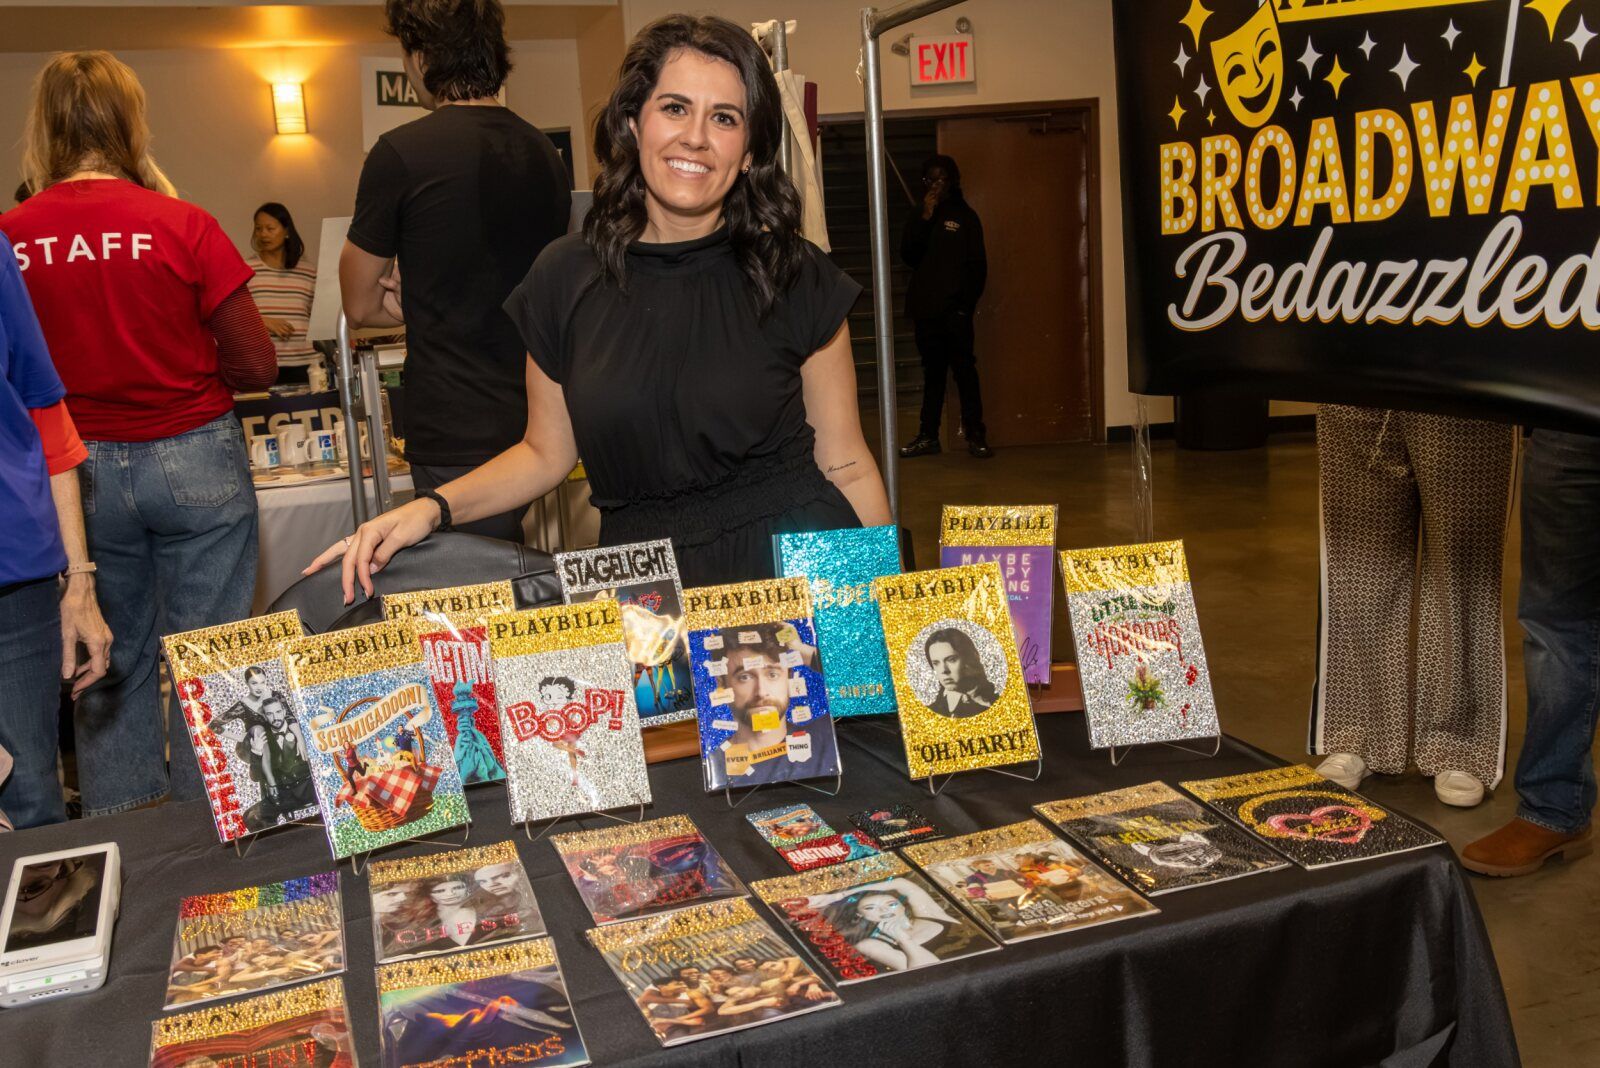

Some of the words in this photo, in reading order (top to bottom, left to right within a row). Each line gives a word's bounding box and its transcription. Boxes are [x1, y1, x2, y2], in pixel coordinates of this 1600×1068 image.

[918, 42, 968, 82] EXIT
[12, 232, 153, 271] STAFF
[1167, 215, 1600, 331] Bedazzled
[949, 516, 1050, 531] PLAYBILL
[564, 546, 671, 587] STAGELIGHT
[391, 591, 505, 619] PLAYBILL
[689, 585, 805, 613] PLAYBILL
[494, 609, 617, 639] PLAYBILL
[175, 621, 296, 661] PLAYBILL
[289, 629, 413, 666] PLAYBILL
[423, 638, 493, 684] AGTIM
[316, 685, 422, 752] SCHMIGADOON!
[726, 755, 749, 763] EVERY
[752, 746, 787, 760] BRILLIANT
[788, 743, 809, 751] THING
[786, 842, 850, 864] RAGTIME
